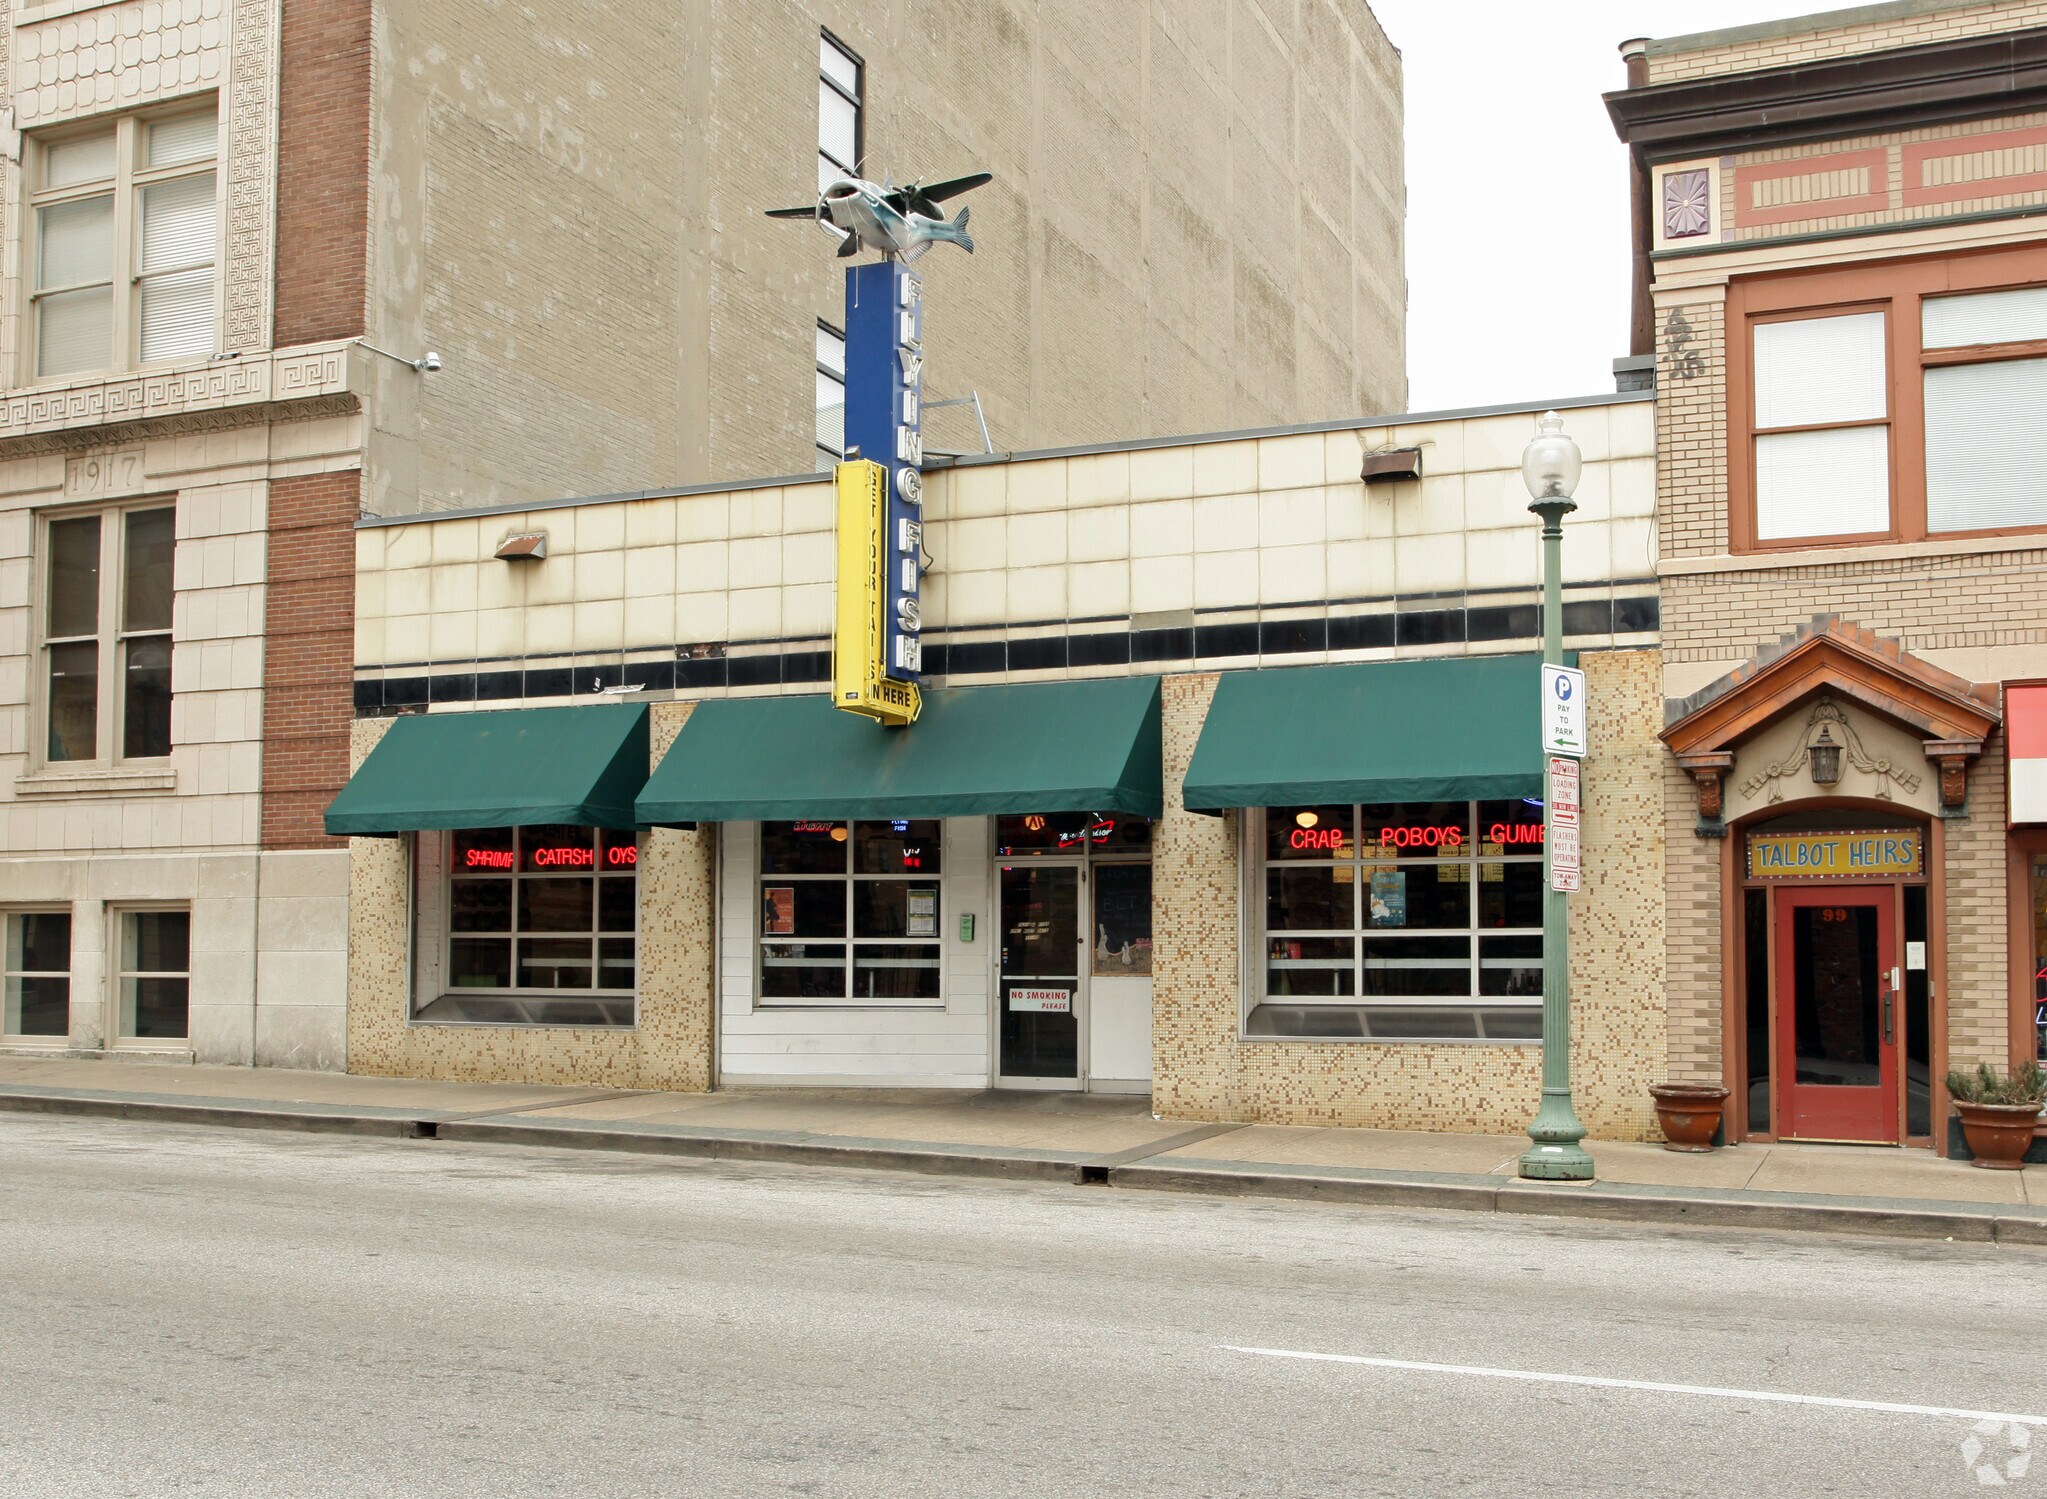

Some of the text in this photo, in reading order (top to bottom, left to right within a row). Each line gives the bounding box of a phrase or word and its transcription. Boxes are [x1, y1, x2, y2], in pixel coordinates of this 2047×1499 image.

[73, 456, 136, 492] 1917
[896, 272, 923, 673] FLYING FISH
[1559, 678, 1570, 697] P
[883, 686, 911, 708] HERE
[1557, 704, 1570, 713] PAY
[1560, 716, 1569, 724] TO
[1555, 726, 1574, 736] PARK
[1552, 761, 1559, 773] NO
[1553, 779, 1577, 790] LOADING
[1558, 790, 1572, 800] ZONE
[1291, 829, 1343, 849] CRAB
[1381, 826, 1462, 847] POBOYS
[1553, 830, 1577, 841] FLASHERS
[1555, 842, 1577, 852] MUST BE
[535, 847, 593, 866] CATFISH
[1553, 853, 1577, 863] OPERATING
[1755, 838, 1914, 868] TALBOT HEIRS
[1554, 872, 1577, 880] TOW-AWAY
[1823, 908, 1847, 922] 99
[1011, 991, 1067, 1000] NO SMOKING
[1041, 1002, 1067, 1010] PLEASE
